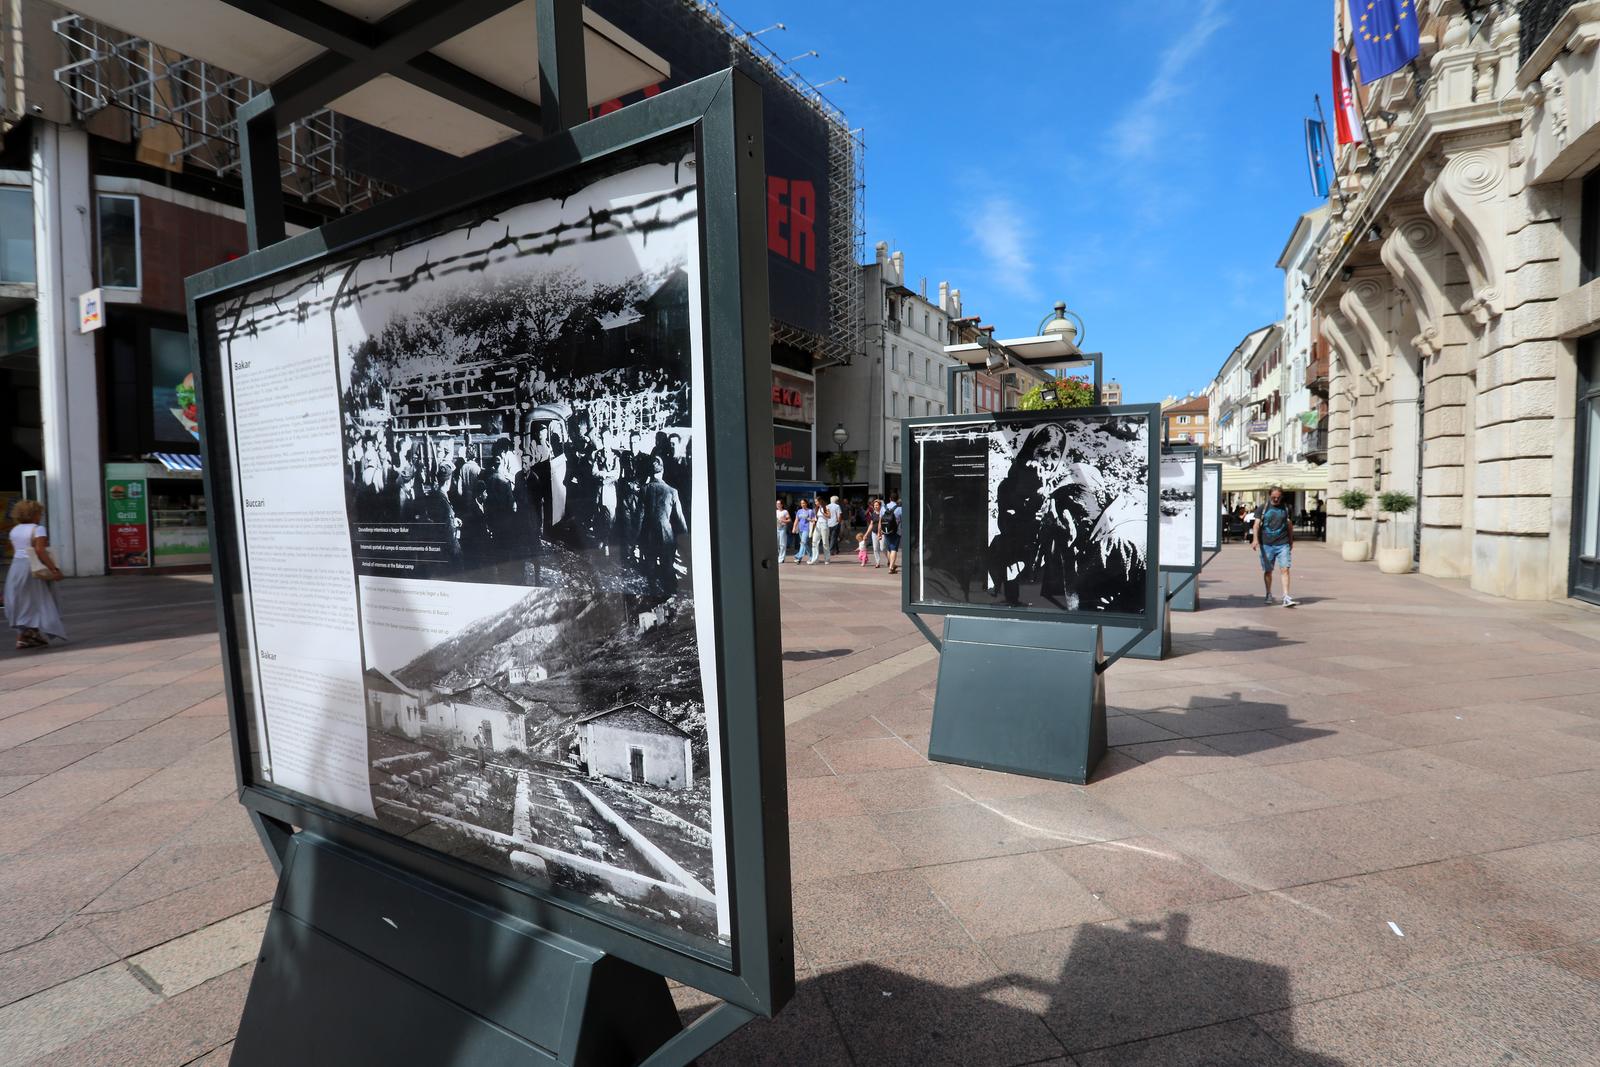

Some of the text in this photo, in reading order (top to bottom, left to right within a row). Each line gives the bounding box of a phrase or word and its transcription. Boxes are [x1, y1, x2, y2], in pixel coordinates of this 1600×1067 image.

[234, 360, 251, 371] Bakar
[245, 498, 265, 508] Buccari
[260, 650, 277, 661] Bakar
